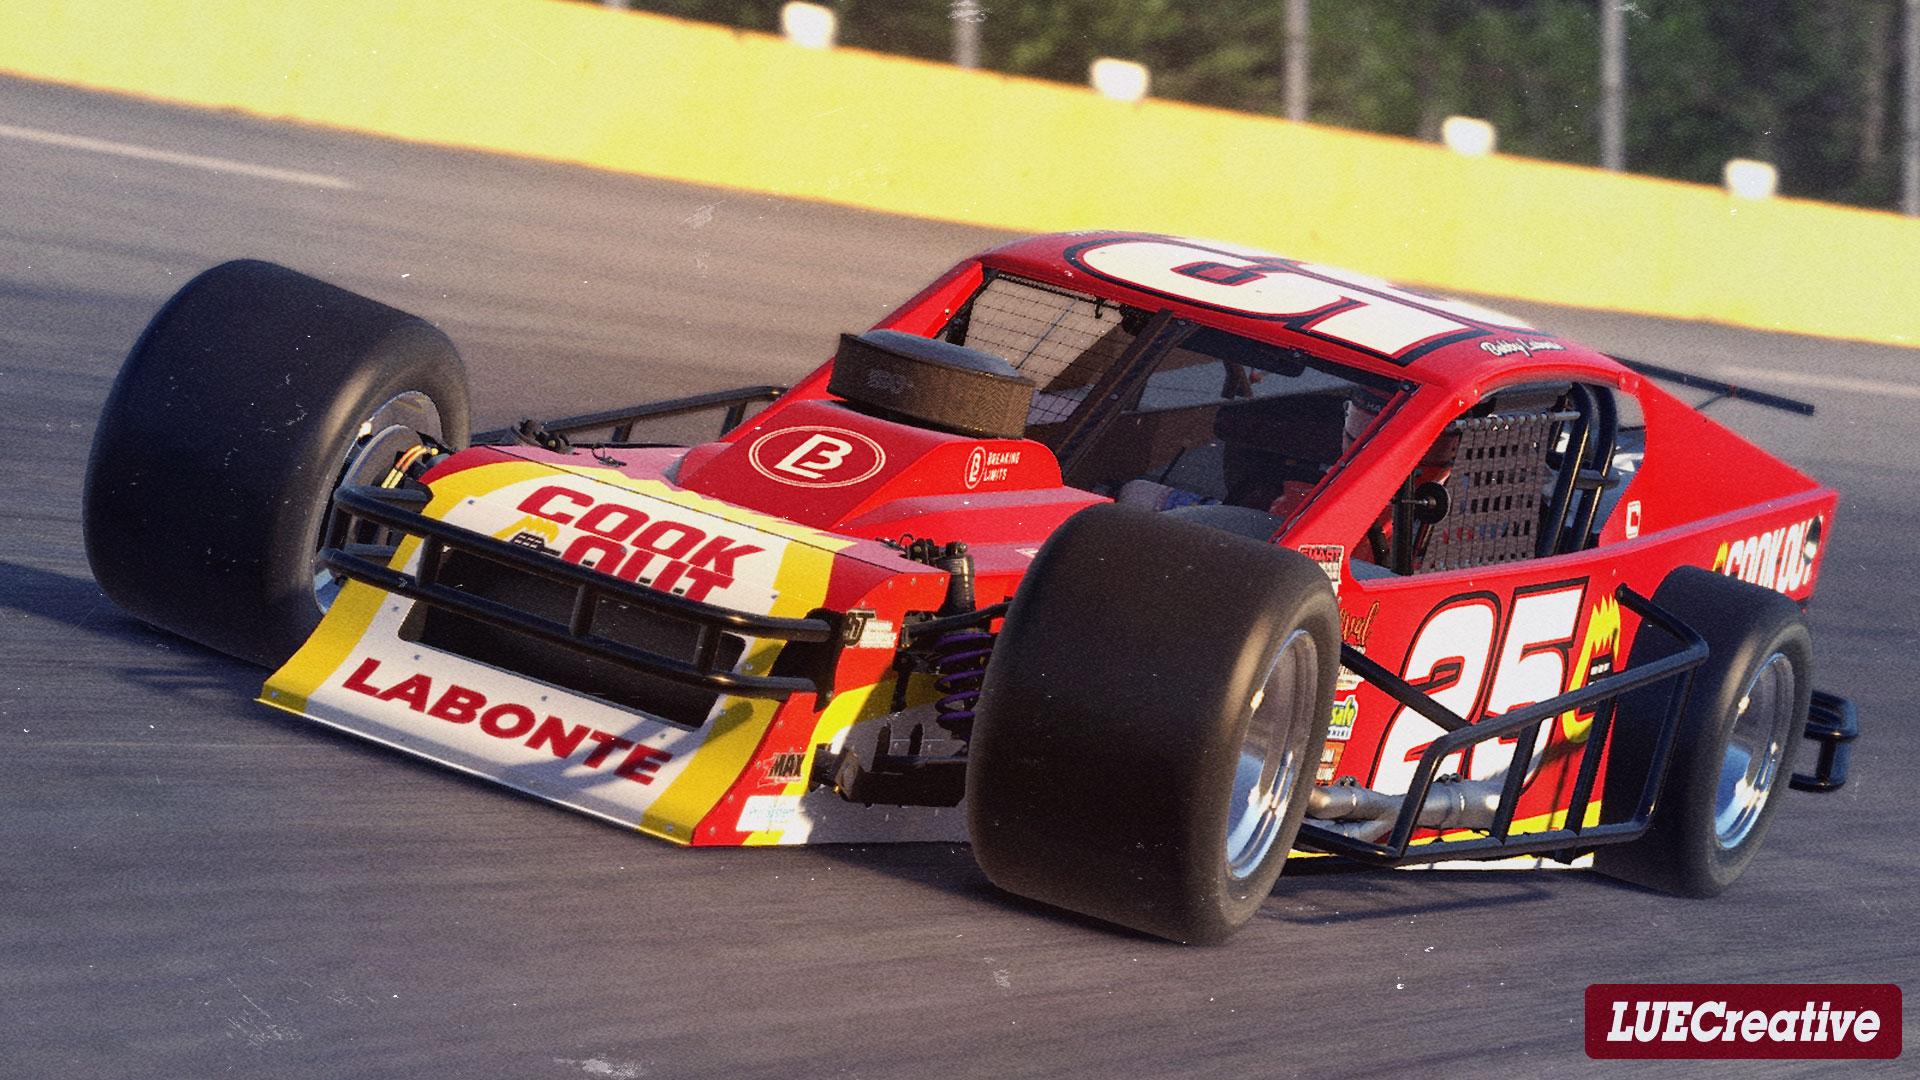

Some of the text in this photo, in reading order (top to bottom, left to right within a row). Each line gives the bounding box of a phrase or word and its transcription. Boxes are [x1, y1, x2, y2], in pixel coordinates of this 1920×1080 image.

[516, 485, 765, 578] COOK
[342, 656, 673, 786] LABONTE
[1370, 580, 1587, 796] 25
